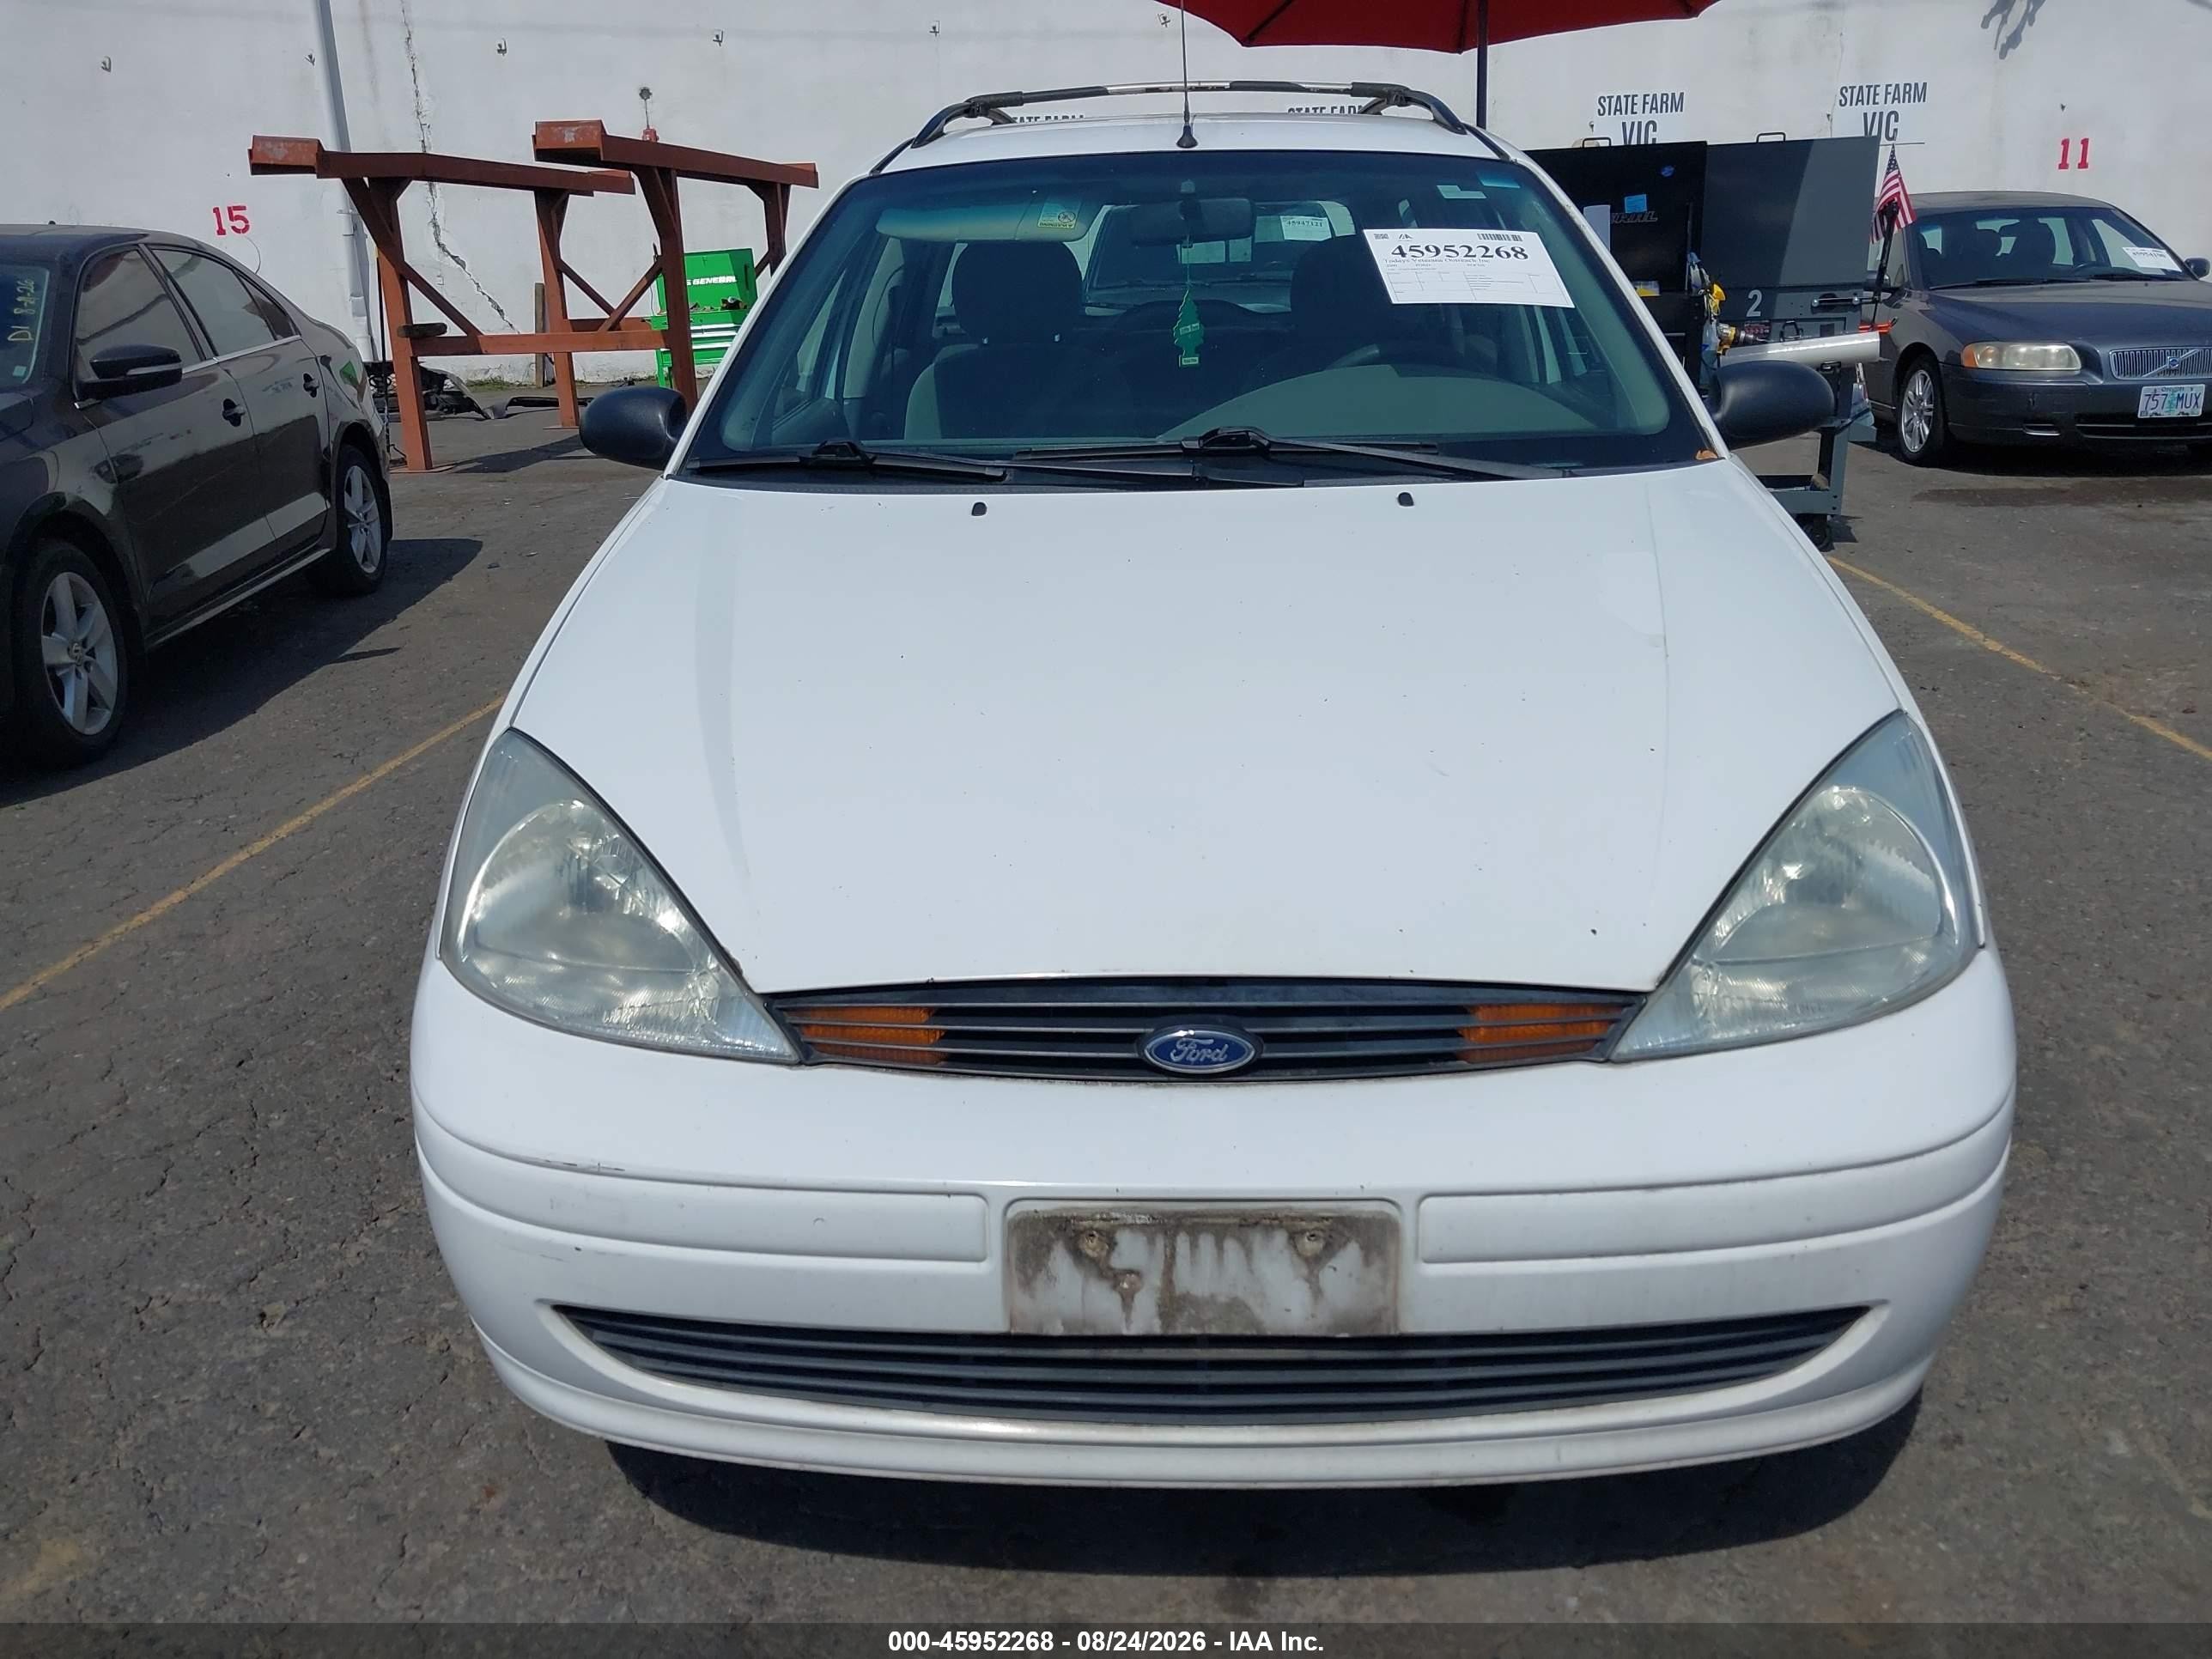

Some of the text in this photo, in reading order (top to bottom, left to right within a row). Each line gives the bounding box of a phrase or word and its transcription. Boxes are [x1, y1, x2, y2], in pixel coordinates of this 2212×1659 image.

[1597, 92, 1685, 116] STATE FARM
[1839, 82, 1928, 106] STATE FARM
[1621, 119, 1657, 145] VIC
[1863, 110, 1899, 142] VIC
[2057, 137, 2089, 170] 11
[212, 204, 251, 236] 15
[1391, 244, 1528, 260] 45952268
[693, 276, 737, 285] GENERAL
[1746, 289, 1763, 318] 2
[2144, 392, 2202, 410] 757 MUX
[1170, 1037, 1230, 1065] Ford
